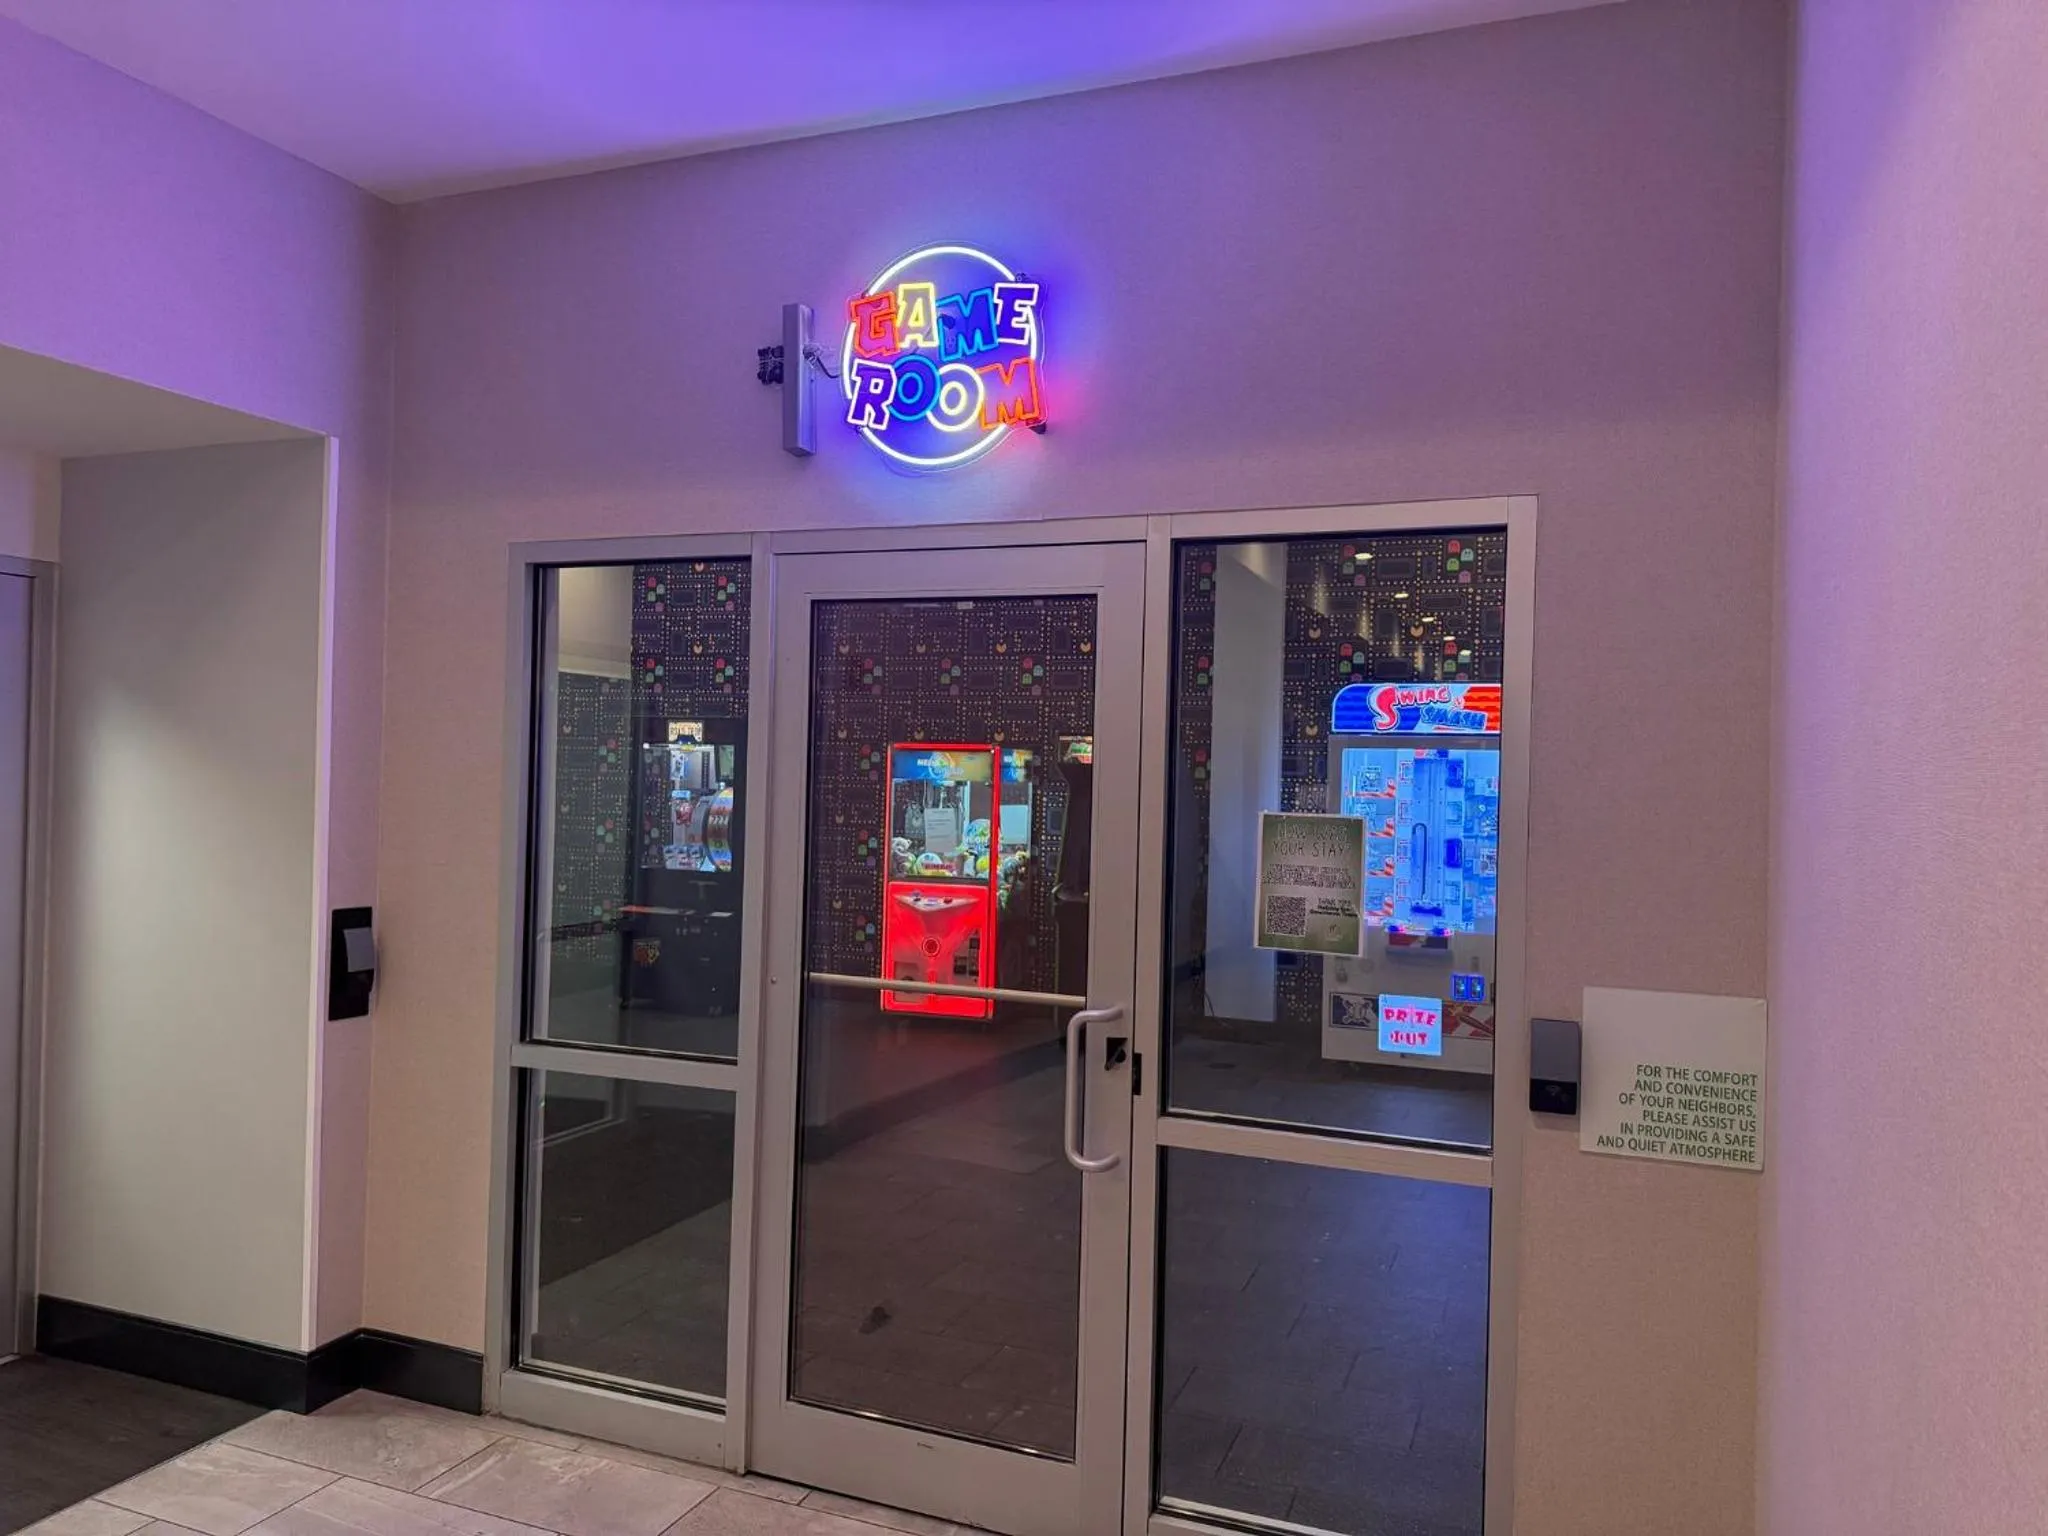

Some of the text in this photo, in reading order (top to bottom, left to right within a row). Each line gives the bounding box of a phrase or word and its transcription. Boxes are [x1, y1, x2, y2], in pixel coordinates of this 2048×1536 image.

[850, 282, 1039, 361] GAME
[847, 354, 1040, 432] ROOM
[1371, 683, 1450, 732] SWING
[1421, 705, 1487, 730] SMASH
[1272, 840, 1305, 856] YOUR
[1384, 1005, 1436, 1026] PRIZE
[1636, 1064, 1758, 1086] FOR THE COMFORT
[1634, 1080, 1757, 1101] AND CONVENIENCE
[1618, 1092, 1756, 1118] OF YOUR NEIGHBORS,
[1643, 1110, 1756, 1132] PLEASE ASSIST US
[1620, 1122, 1756, 1148] IN PROVIDING A SAFE
[1596, 1135, 1756, 1163] AND QUIET ATMOSPHERE
